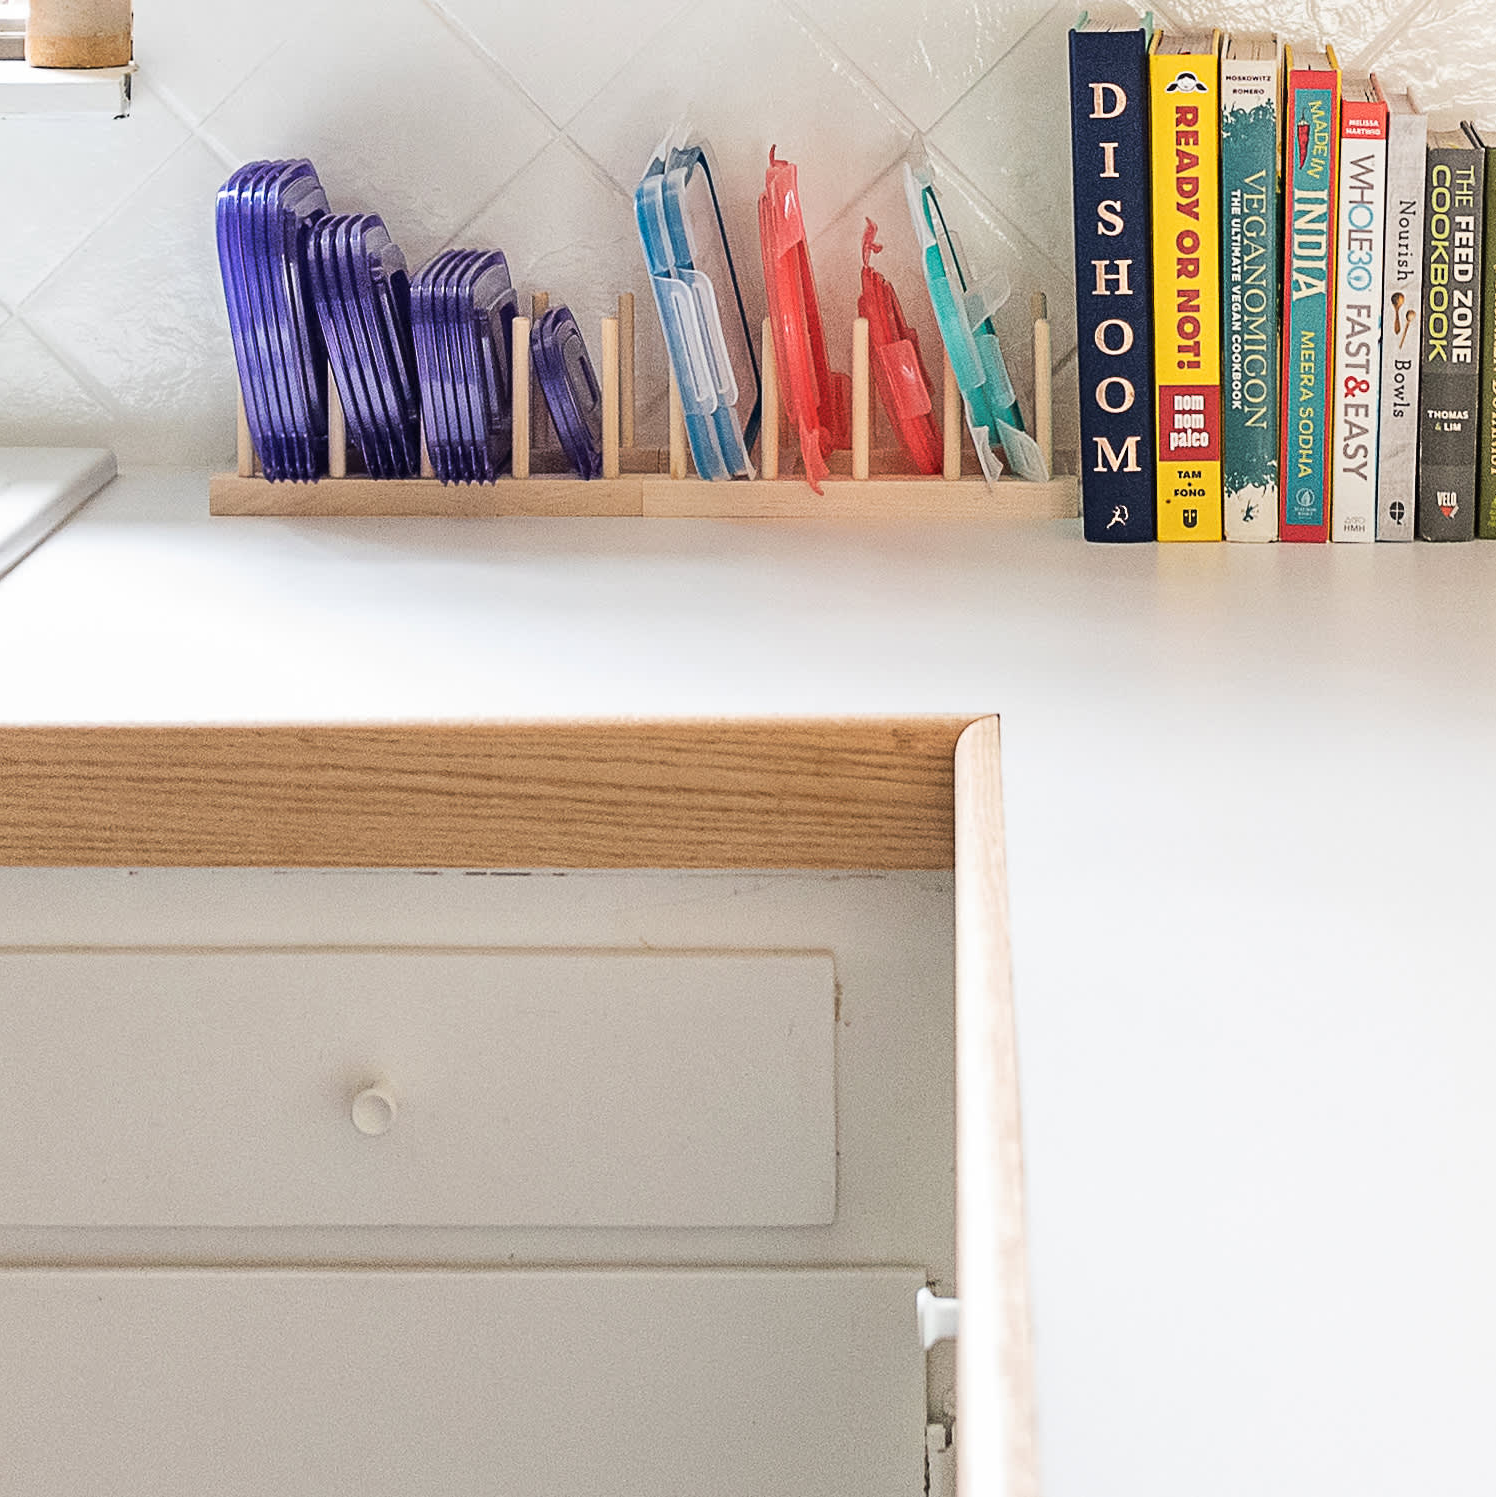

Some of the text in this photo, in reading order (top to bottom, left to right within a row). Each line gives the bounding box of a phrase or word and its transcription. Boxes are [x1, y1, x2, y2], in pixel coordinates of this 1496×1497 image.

[1232, 88, 1265, 96] ROMERO
[1348, 119, 1380, 127] MELISSA
[1089, 83, 1142, 473] DISHOOM
[1175, 105, 1201, 370] READY OR NOT!
[1292, 100, 1330, 302] MADE IN INDIA
[1428, 164, 1452, 362] COOKBOOK
[1451, 165, 1476, 363] THE FEED ZONE
[1231, 189, 1243, 410] THE ULTIMATE VEGAN COOKBOOK
[1243, 169, 1268, 430] VEGANOMICON
[1343, 154, 1375, 481] WHOLE30 FAST & EASY
[1393, 200, 1417, 418] Nourish Bowls
[1174, 395, 1204, 411] nom
[1174, 413, 1204, 429] nom
[1177, 471, 1202, 479] TAM
[1298, 330, 1316, 478] MEERA SODHA
[1427, 410, 1469, 419] THOMAS
[1443, 422, 1462, 431] LIM
[1436, 491, 1457, 507] VELO
